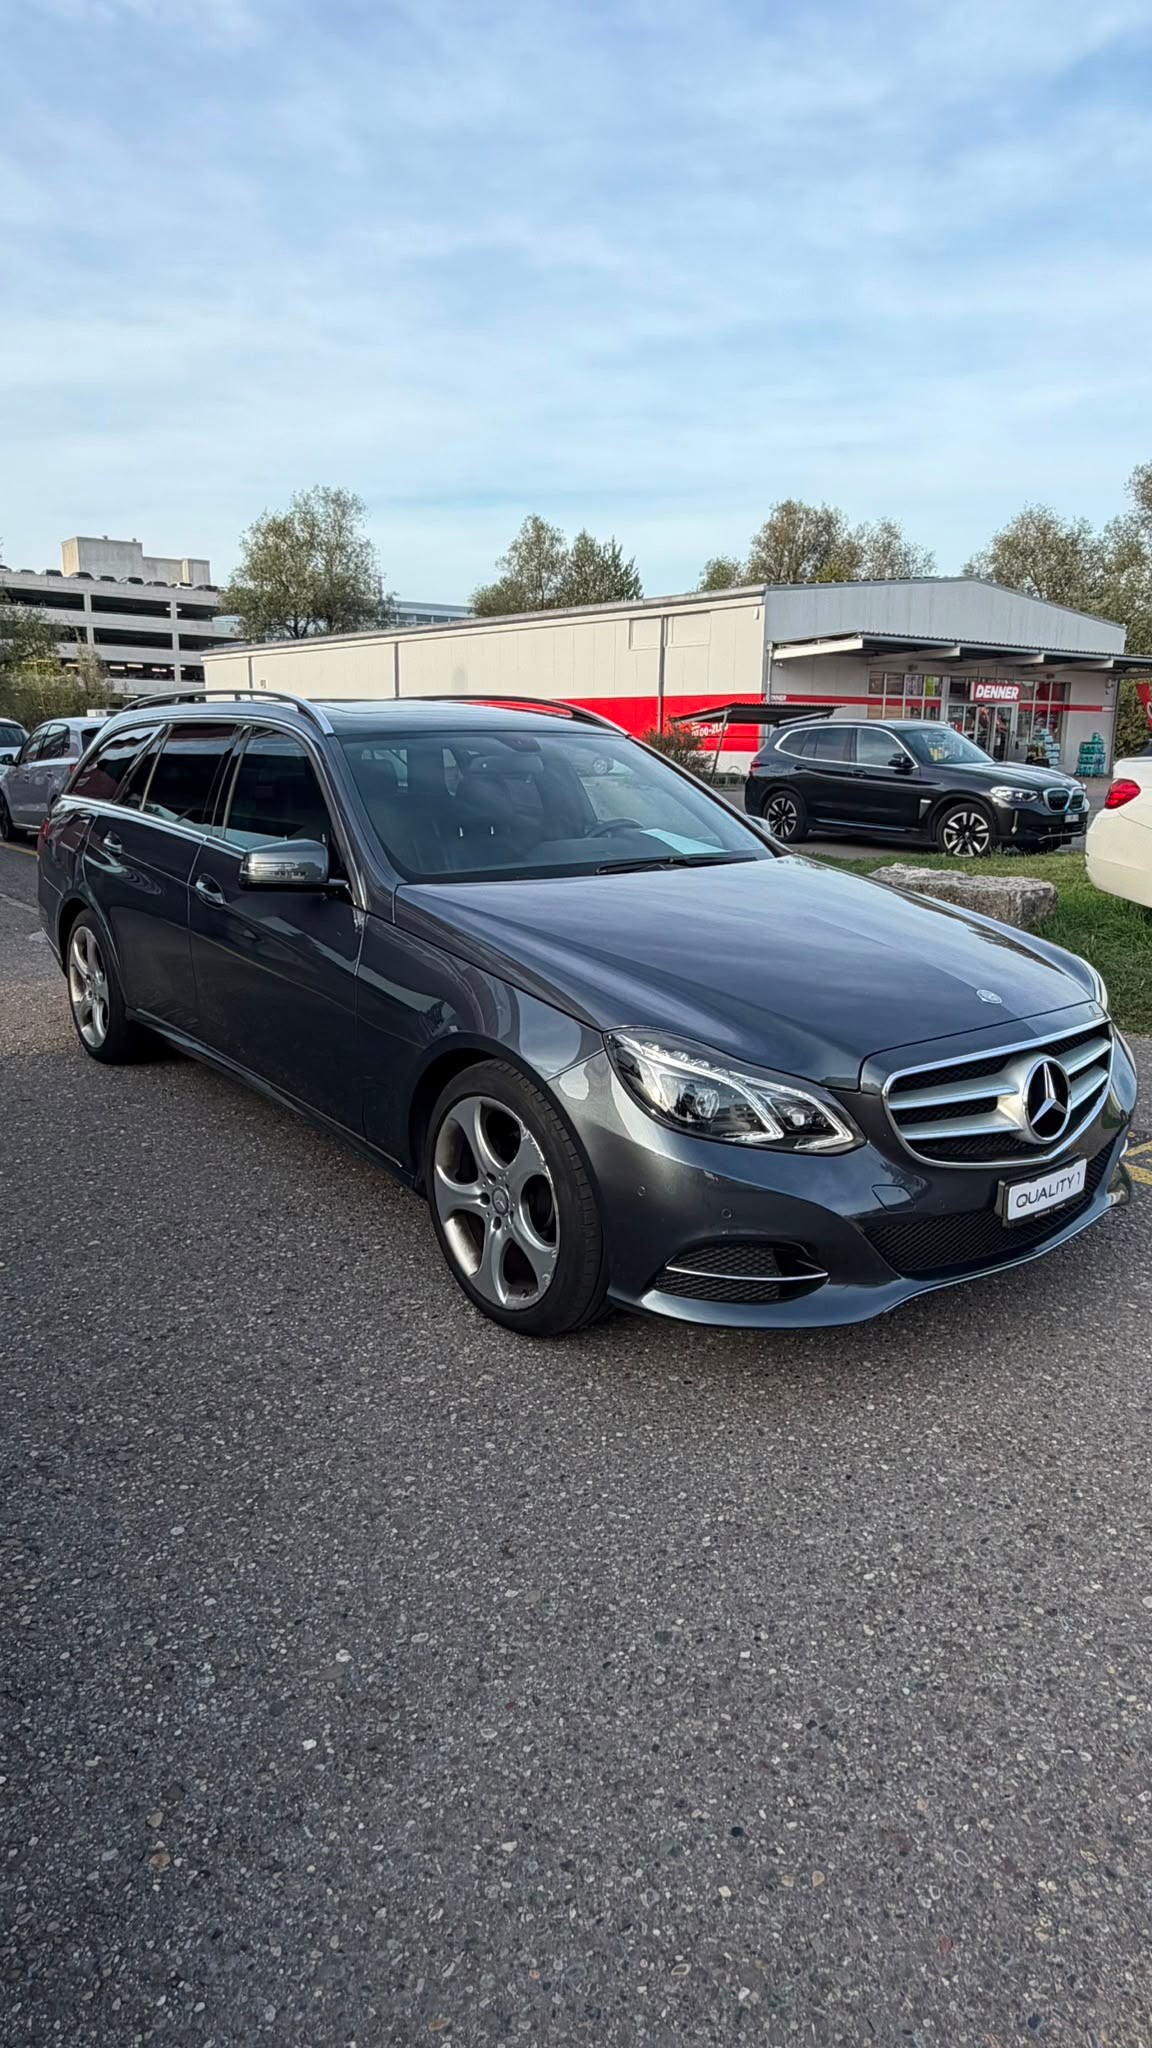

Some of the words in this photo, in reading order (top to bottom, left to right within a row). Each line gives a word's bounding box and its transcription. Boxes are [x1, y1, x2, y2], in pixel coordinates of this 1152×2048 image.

[975, 685, 1019, 700] DENNER
[1016, 1175, 1075, 1208] QUALITY
[1076, 1172, 1081, 1185] 1
